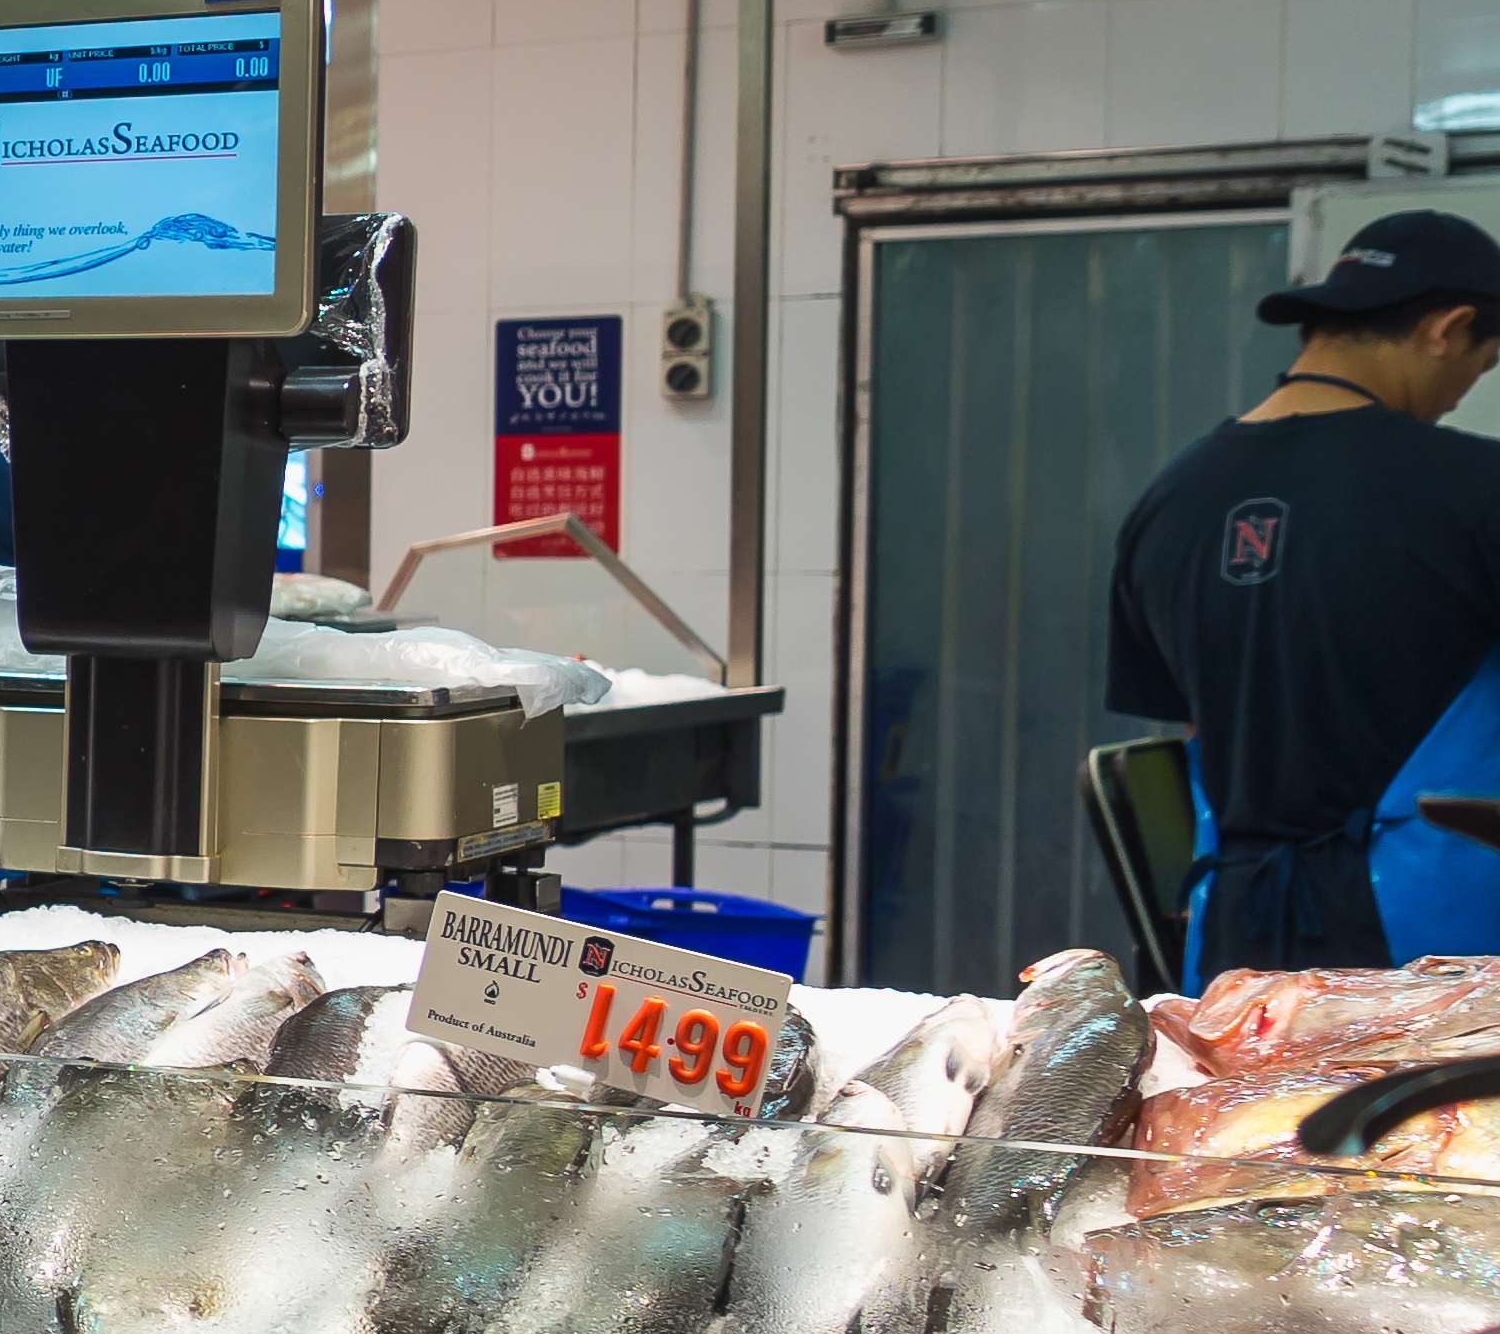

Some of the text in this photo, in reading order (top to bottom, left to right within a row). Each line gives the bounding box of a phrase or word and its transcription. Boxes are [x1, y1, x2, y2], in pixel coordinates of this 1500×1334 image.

[46, 68, 63, 88] UF
[138, 62, 171, 83] 0.00
[236, 57, 269, 78] 0.00
[13, 223, 44, 239] thing
[48, 226, 66, 236] we
[68, 221, 128, 236] overlook,
[516, 336, 597, 358] seafood
[516, 383, 598, 409] YOU!
[1230, 518, 1277, 564] N
[441, 911, 573, 968] BARRAMUNDI
[457, 947, 542, 984] SMALL
[427, 1009, 536, 1048] Product of Australia
